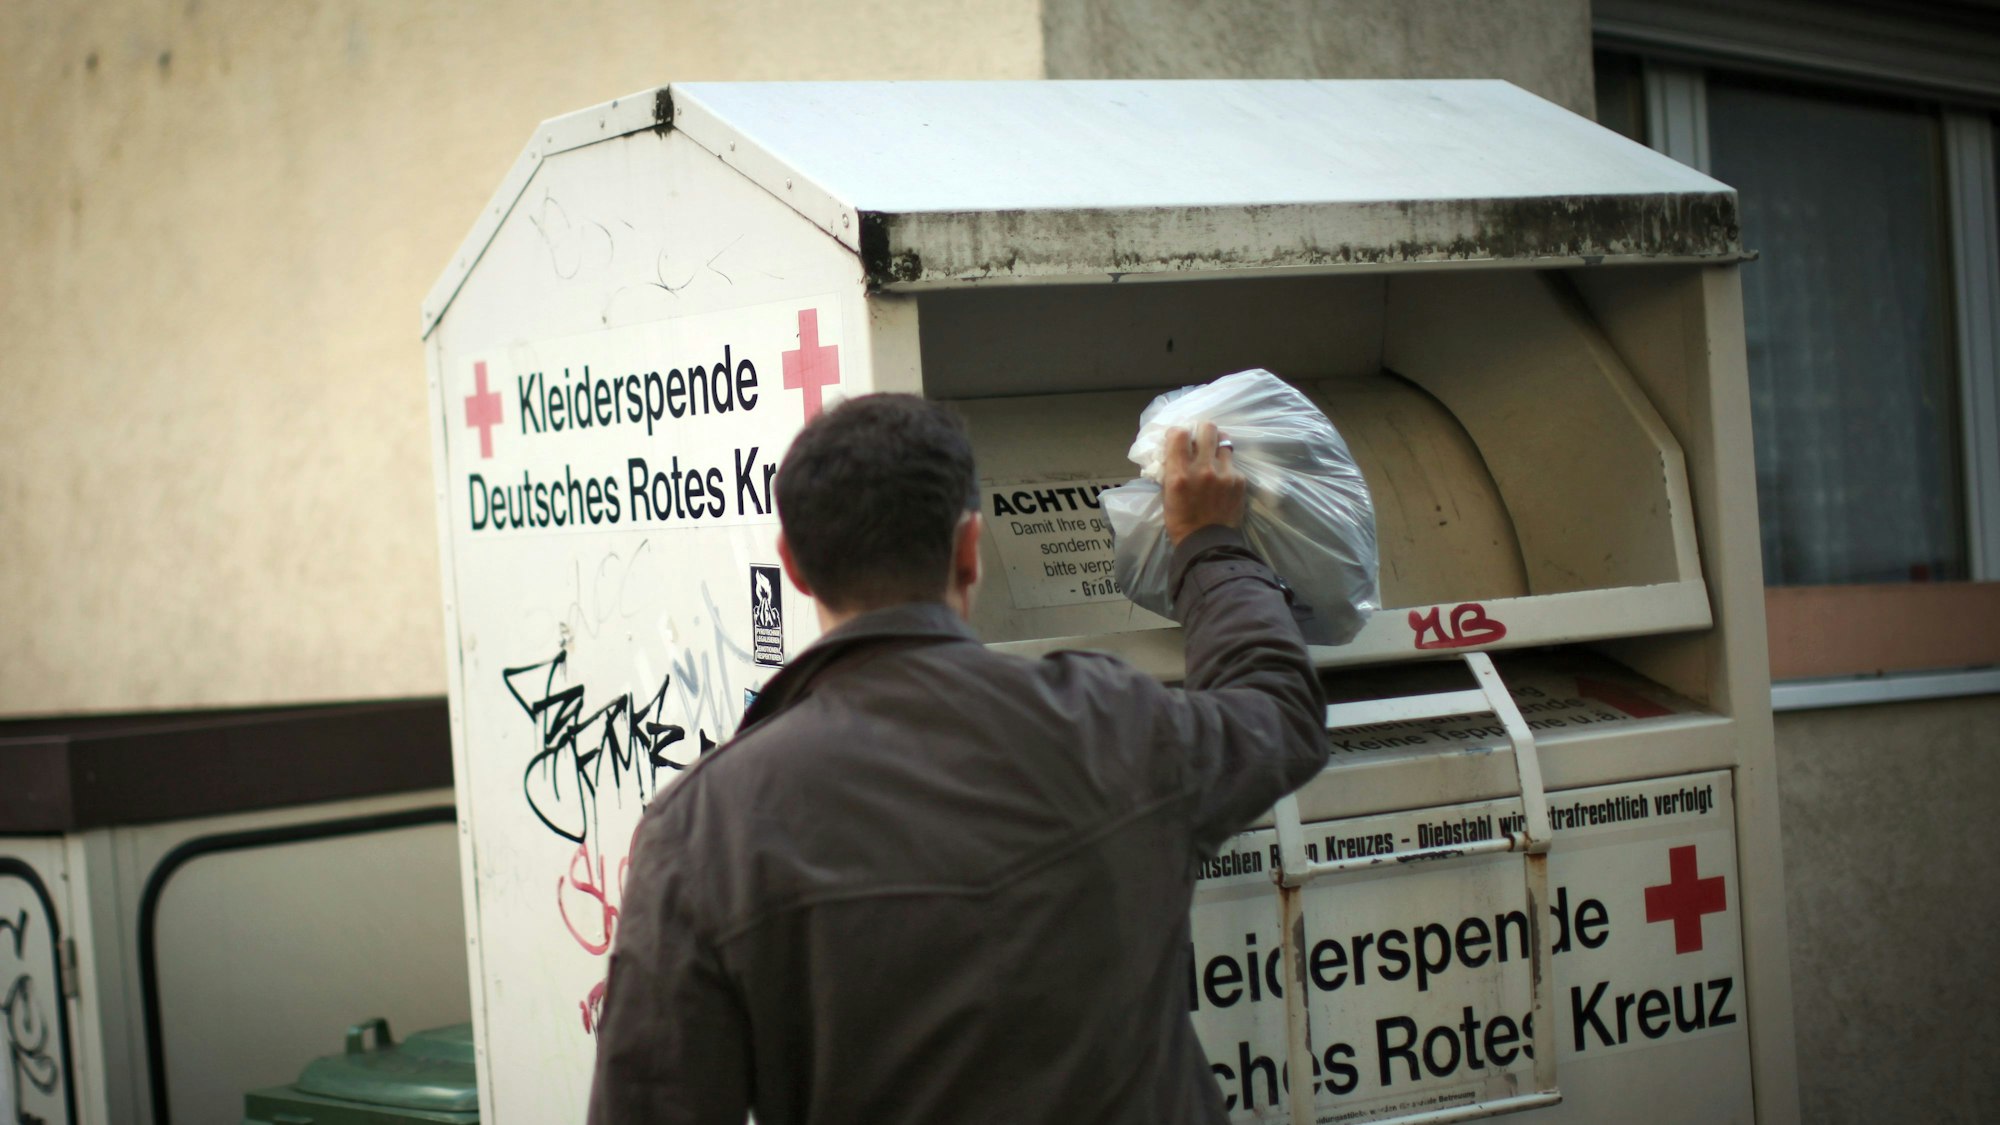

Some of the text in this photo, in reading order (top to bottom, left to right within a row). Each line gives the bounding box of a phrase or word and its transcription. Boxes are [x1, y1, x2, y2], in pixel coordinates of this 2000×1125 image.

[518, 344, 759, 436] Kleiderspende
[468, 446, 777, 531] Deutsches Rotes Kr
[992, 484, 1121, 517] ACHTU
[1011, 520, 1056, 536] Damit
[1056, 518, 1086, 533] Ihre
[1040, 538, 1101, 555] sondern
[1043, 561, 1077, 577] bitte
[1333, 734, 1427, 753] Keine
[1197, 849, 1262, 880] tschen
[1325, 832, 1394, 861] Kreuzes
[1418, 814, 1492, 849] Diebstahl
[1499, 811, 1526, 836] wir
[1548, 794, 1648, 831] trafrechtlich
[1655, 784, 1713, 816] verfolgt
[1570, 977, 1737, 1053] Kreuz
